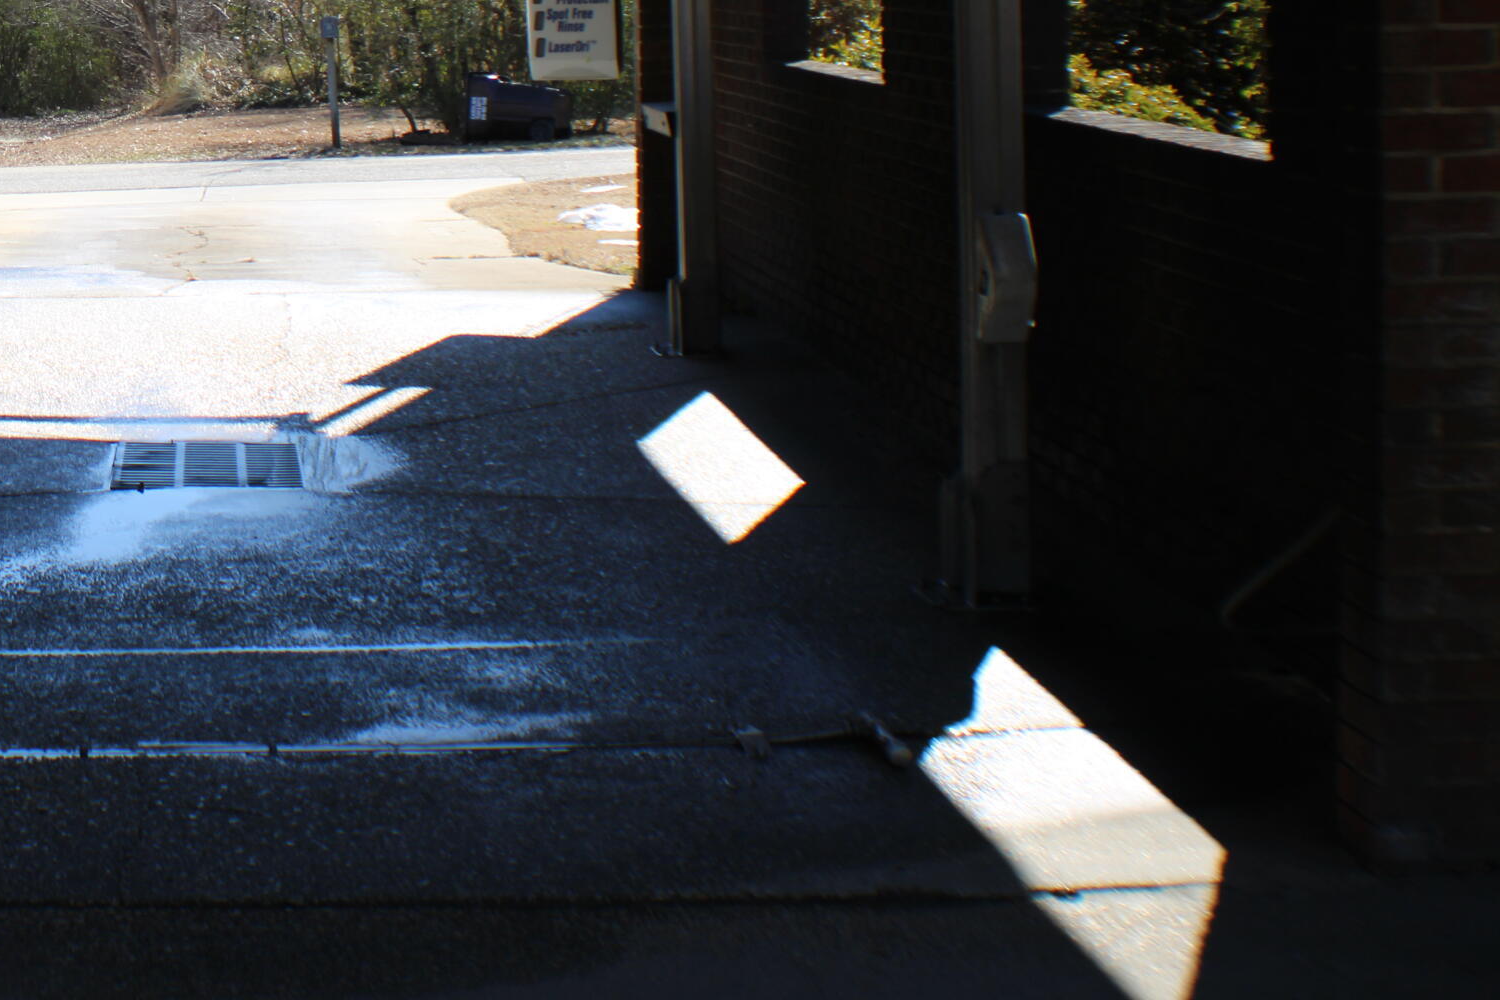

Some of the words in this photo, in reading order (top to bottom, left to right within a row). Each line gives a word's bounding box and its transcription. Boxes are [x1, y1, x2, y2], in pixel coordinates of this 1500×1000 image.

[546, 8, 570, 21] Spot
[572, 8, 594, 20] Free
[557, 20, 585, 32] Rinse
